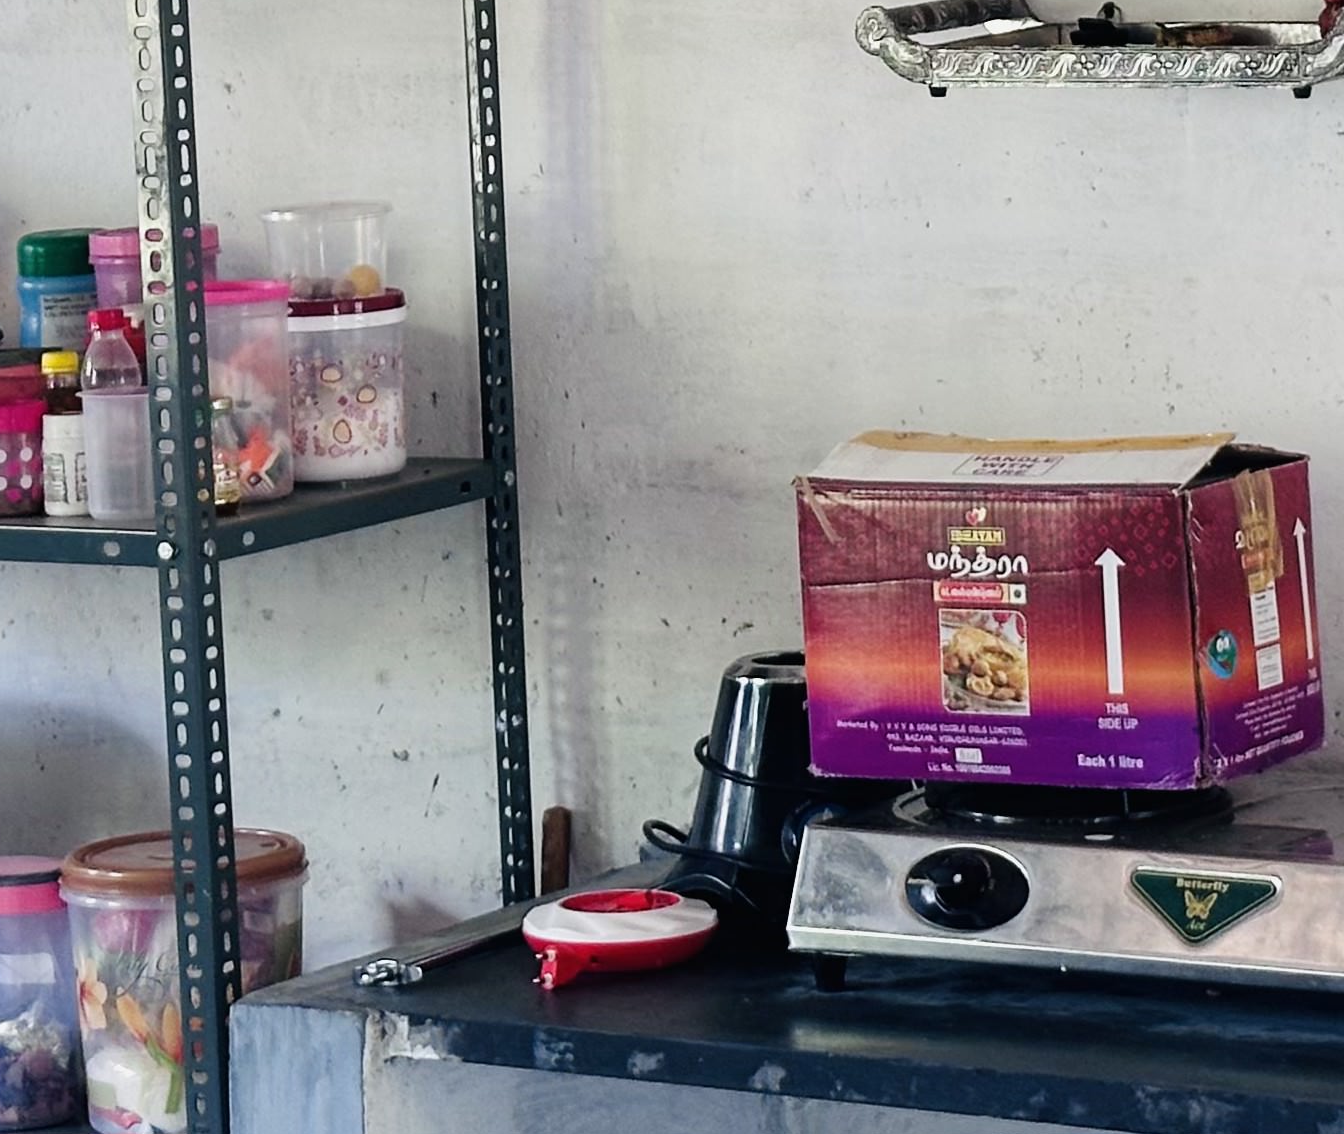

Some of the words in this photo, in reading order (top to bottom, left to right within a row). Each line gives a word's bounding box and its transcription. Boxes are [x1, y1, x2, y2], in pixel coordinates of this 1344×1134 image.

[973, 455, 1058, 463] HANDLE
[972, 468, 1026, 476] CARE
[1105, 702, 1129, 715] THIS
[1098, 716, 1122, 730] SIDE
[1123, 717, 1139, 730] UP
[1076, 753, 1106, 767] Each
[1108, 754, 1116, 768] 1
[1118, 754, 1144, 769] litre
[1175, 877, 1230, 893] Butterfly
